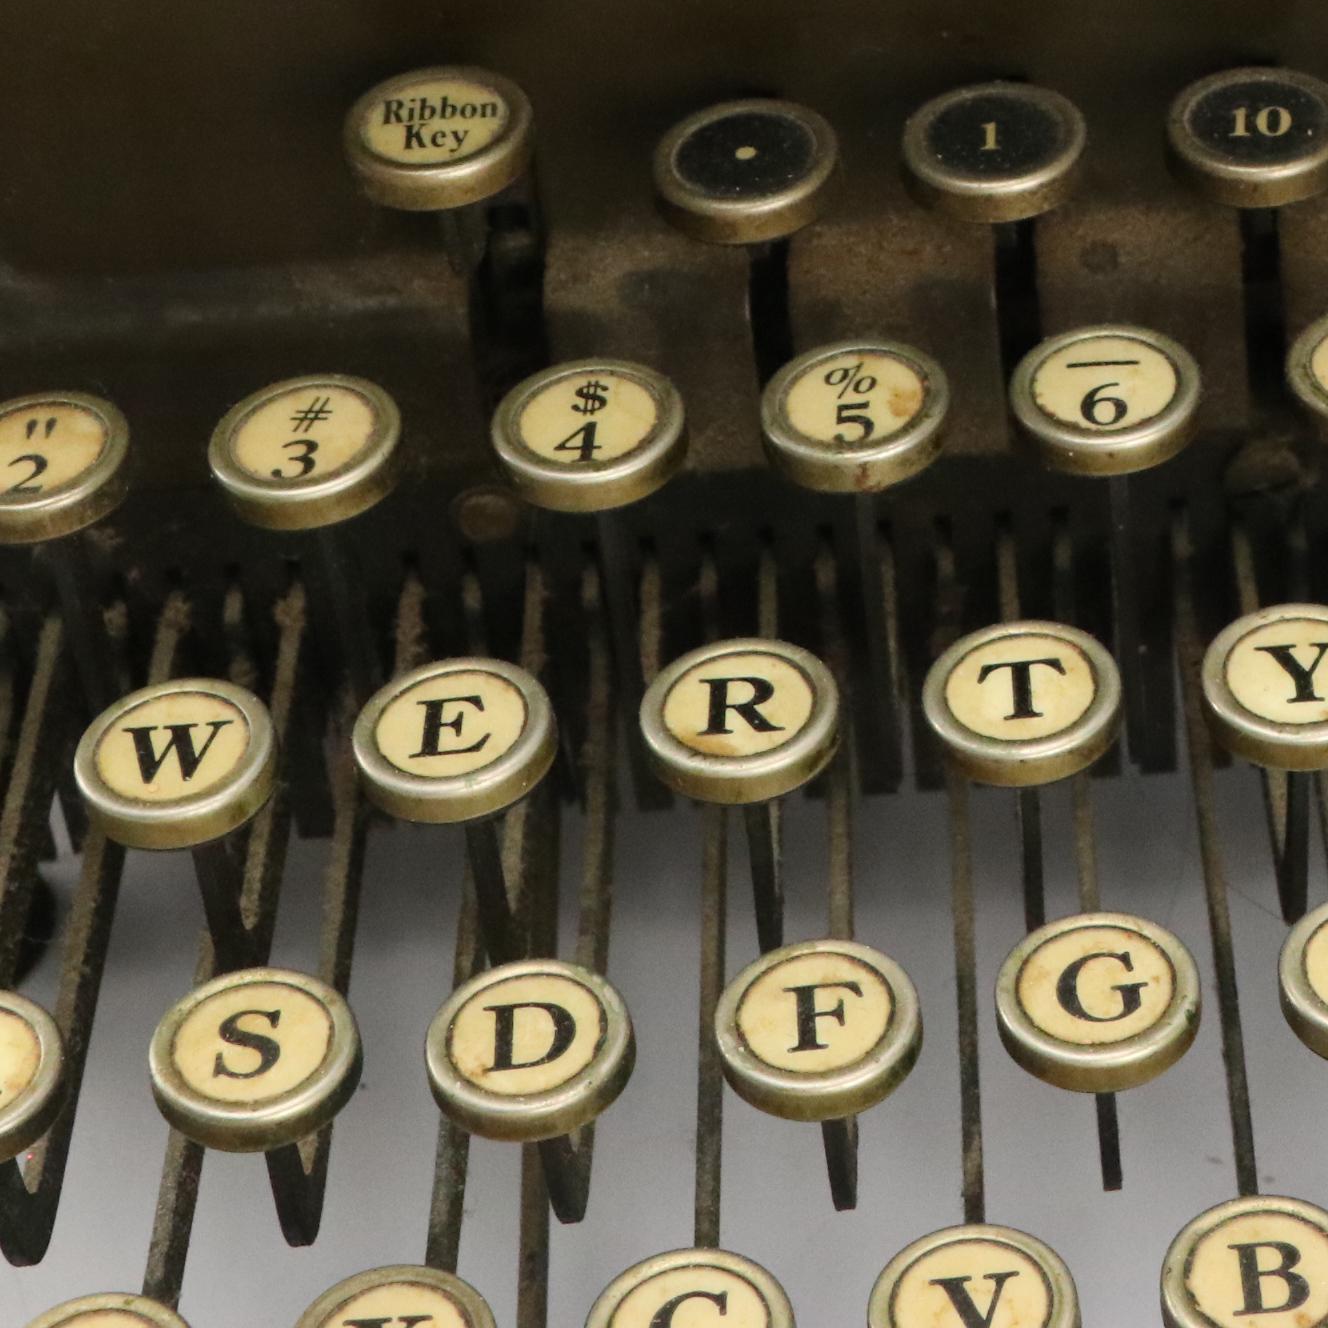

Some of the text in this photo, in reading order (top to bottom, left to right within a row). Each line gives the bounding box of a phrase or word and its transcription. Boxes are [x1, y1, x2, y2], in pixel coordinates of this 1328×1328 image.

[381, 96, 499, 126] Ribbon
[1230, 107, 1291, 136] 10
[404, 123, 468, 153] Key
[981, 122, 997, 149] 1
[571, 381, 608, 415] $
[823, 362, 877, 398] %
[290, 396, 332, 432] #
[834, 405, 875, 444] 5
[1080, 383, 1127, 426] 6
[271, 440, 317, 479] 3
[553, 422, 602, 462] 4
[4, 454, 48, 494] 2
[697, 677, 785, 736] R
[978, 658, 1066, 720] T
[409, 696, 490, 758] E
[123, 721, 233, 784] W
[1056, 952, 1148, 1022] G
[483, 1002, 576, 1070] D
[783, 981, 862, 1052] F
[213, 1010, 281, 1079] S
[929, 1271, 1019, 1328] V
[1228, 1242, 1310, 1316] B
